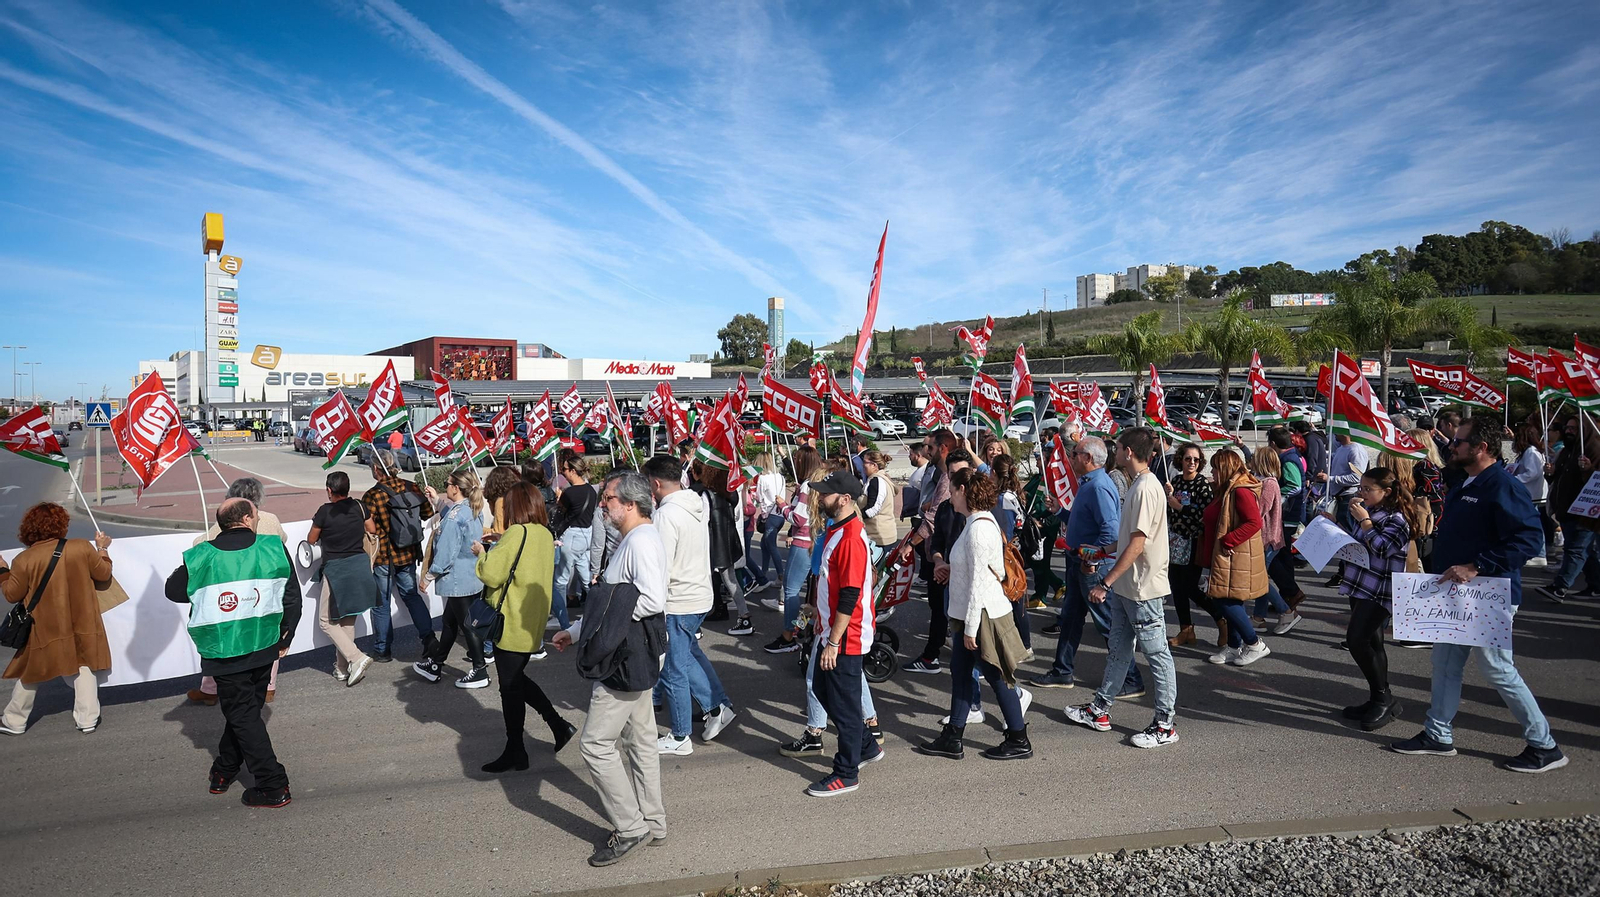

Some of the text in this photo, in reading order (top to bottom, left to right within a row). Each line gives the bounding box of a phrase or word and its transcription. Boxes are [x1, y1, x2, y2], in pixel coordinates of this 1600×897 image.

[219, 328, 237, 336] ZARA
[604, 361, 676, 376] Media Markt
[1411, 363, 1463, 382] CCOO
[264, 371, 366, 386] areasur
[1438, 380, 1461, 392] Cádiz
[1466, 376, 1503, 406] COO
[762, 385, 817, 428] CCOO
[132, 394, 177, 447] UGT
[1411, 579, 1506, 604] LOS DOMINGOS
[1427, 607, 1474, 622] FAMILIA
